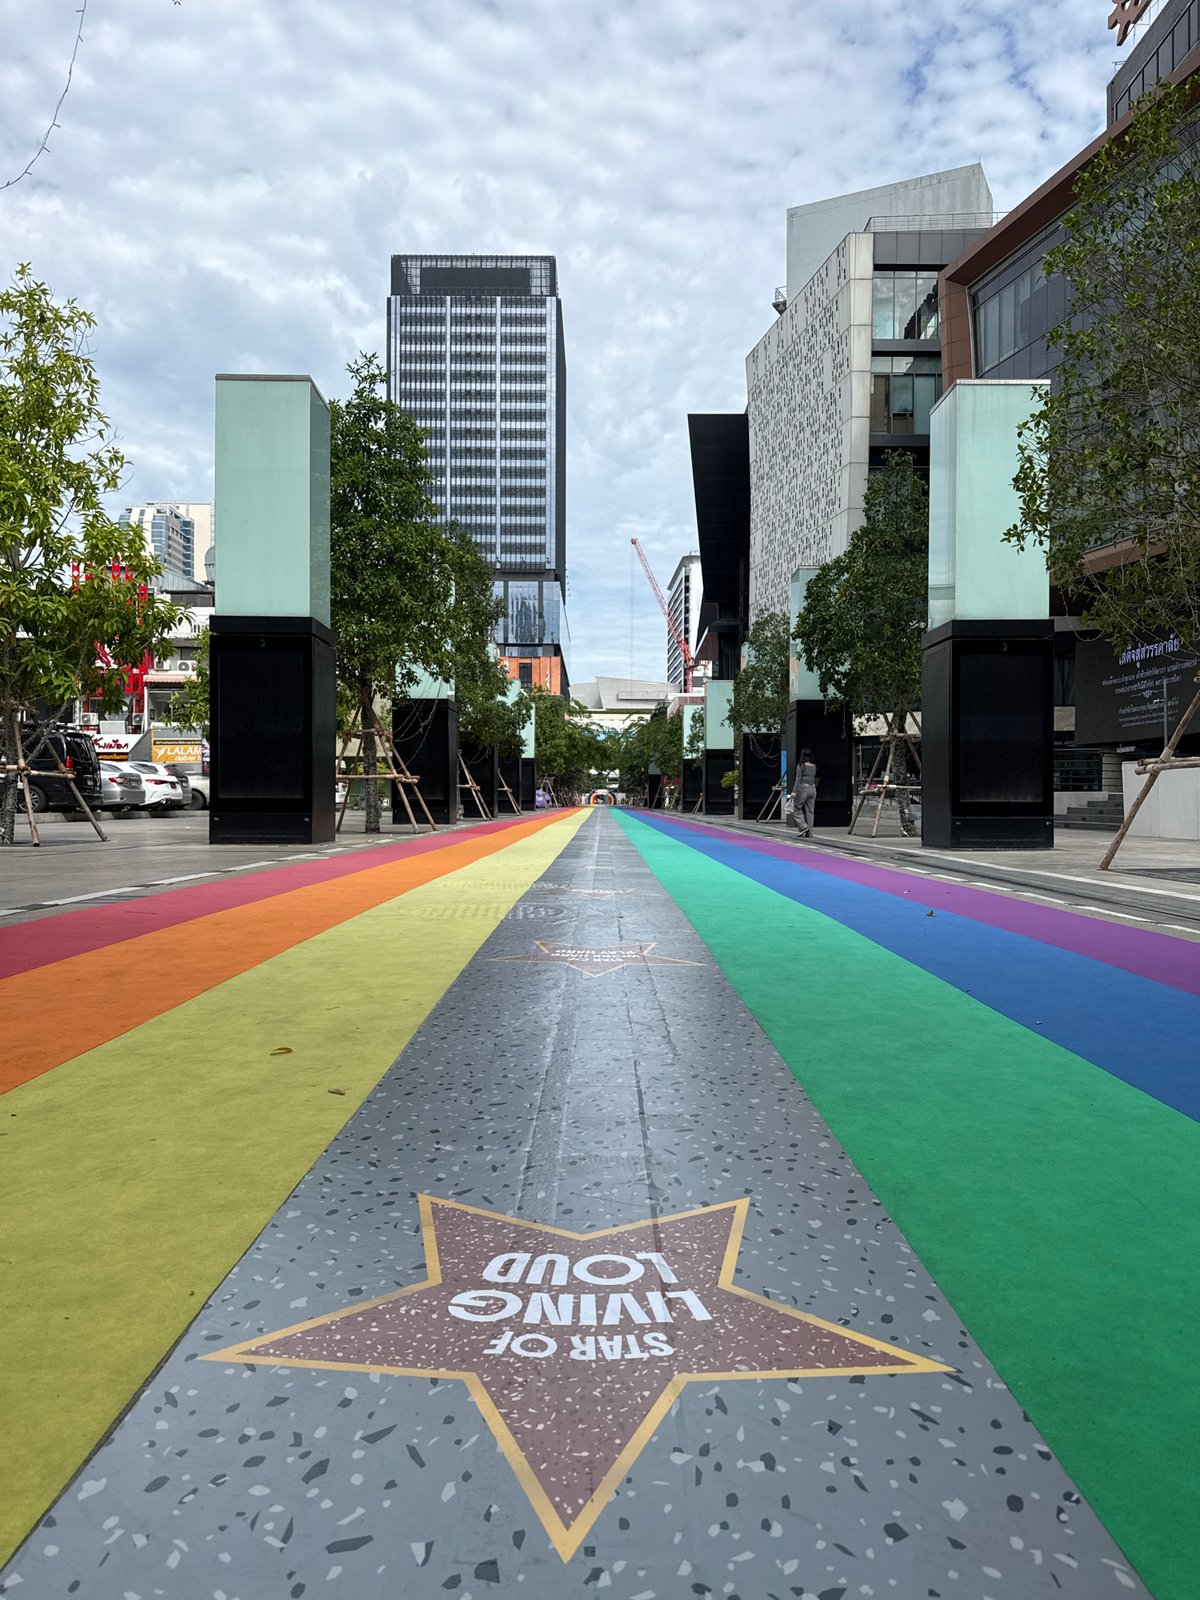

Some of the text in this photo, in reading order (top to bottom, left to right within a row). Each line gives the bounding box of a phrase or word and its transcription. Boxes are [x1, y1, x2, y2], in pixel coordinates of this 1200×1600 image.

[482, 1252, 679, 1286] LOUD
[448, 1289, 713, 1326] LIVING
[482, 1330, 676, 1361] STAR OF
